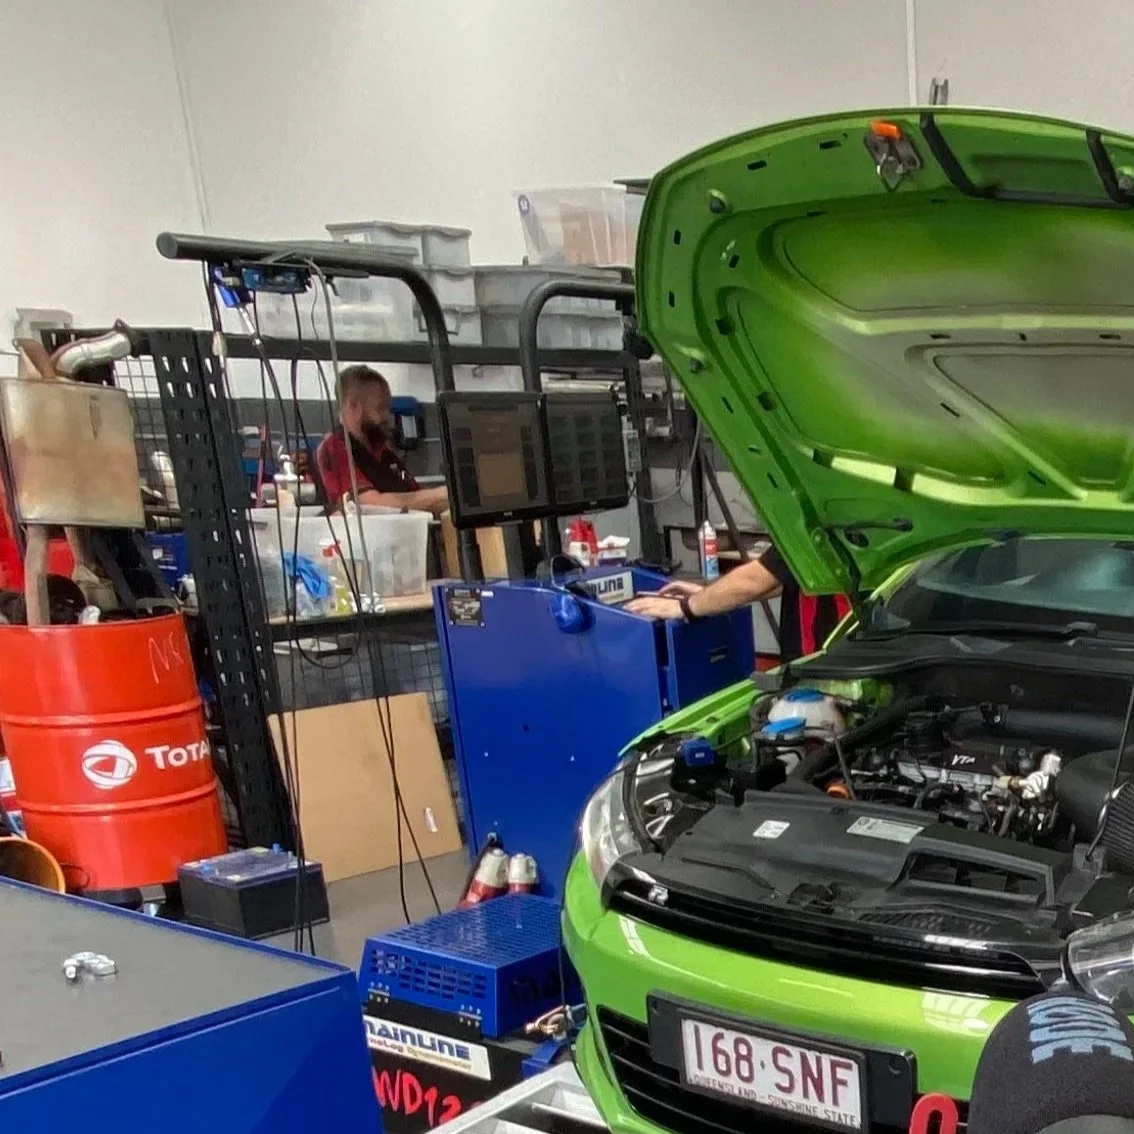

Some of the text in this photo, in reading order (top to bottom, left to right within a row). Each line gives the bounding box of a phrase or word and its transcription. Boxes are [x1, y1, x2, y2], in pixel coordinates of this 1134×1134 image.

[694, 1024, 854, 1107] 168 SNF
[693, 1075, 857, 1127] QUEENSLAND SUNSHINE STATE
